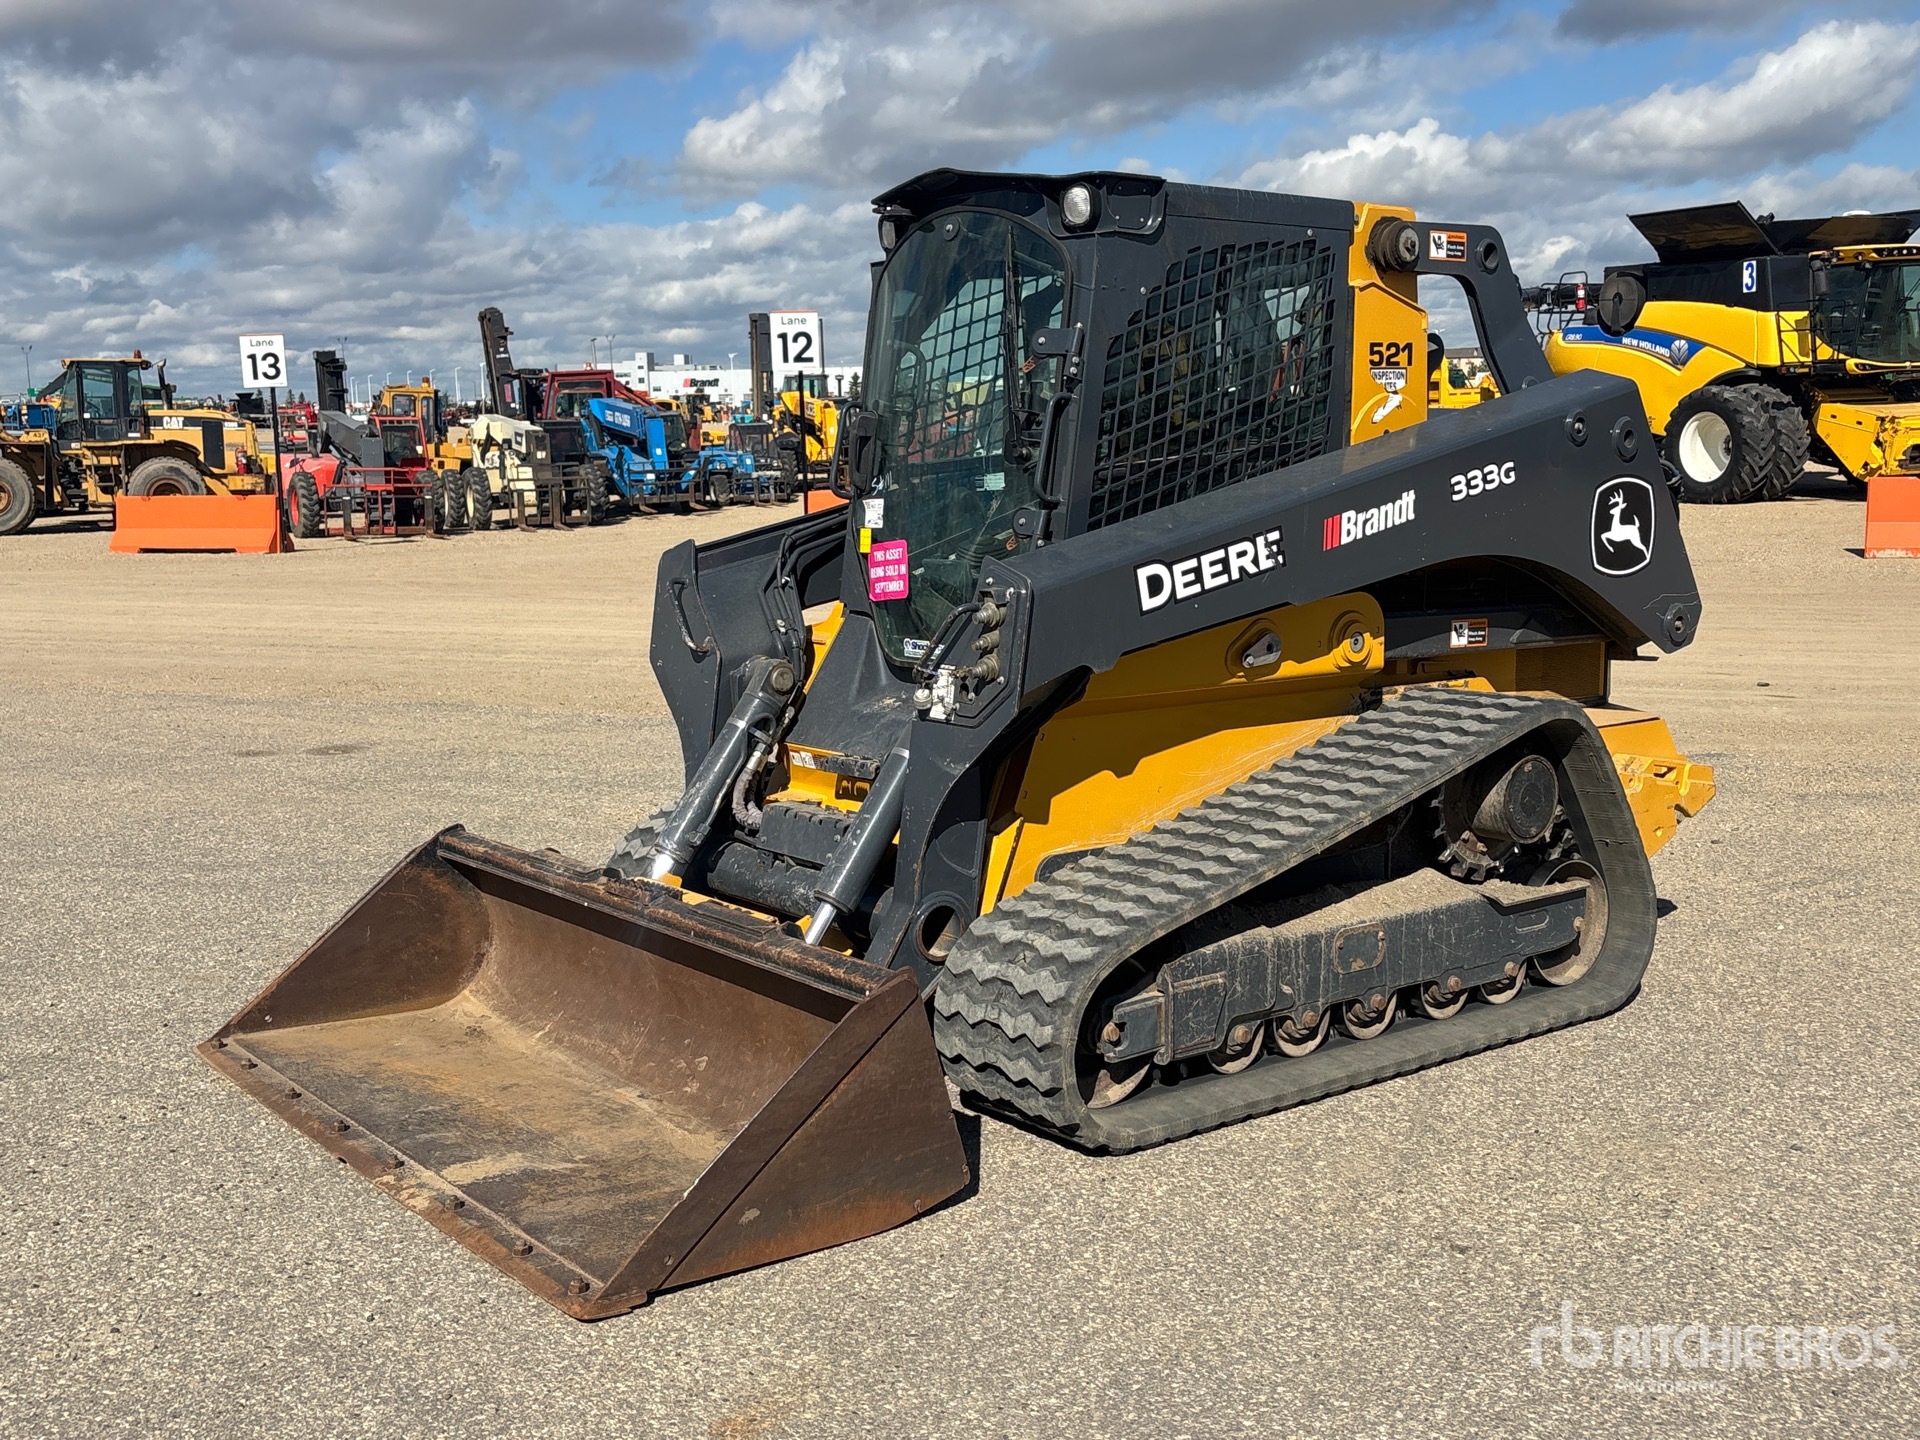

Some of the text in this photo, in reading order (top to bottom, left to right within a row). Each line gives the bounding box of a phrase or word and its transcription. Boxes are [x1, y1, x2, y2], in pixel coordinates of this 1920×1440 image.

[1744, 262, 1755, 292] 3
[781, 316, 807, 326] Lane
[249, 338, 274, 347] Lane
[776, 331, 814, 364] 12
[1622, 337, 1671, 358] NEW HOLLAND
[1369, 342, 1413, 366] 521
[246, 352, 281, 381] 13
[689, 377, 720, 388] Brandt
[162, 416, 185, 430] CAT
[1450, 461, 1516, 502] 333G
[1340, 489, 1416, 546] Brandt
[873, 547, 903, 563] THIS ASSET
[870, 563, 907, 579] BEING SOLD IN
[1136, 529, 1284, 612] DEERE
[874, 579, 905, 594] SEPTEMBER
